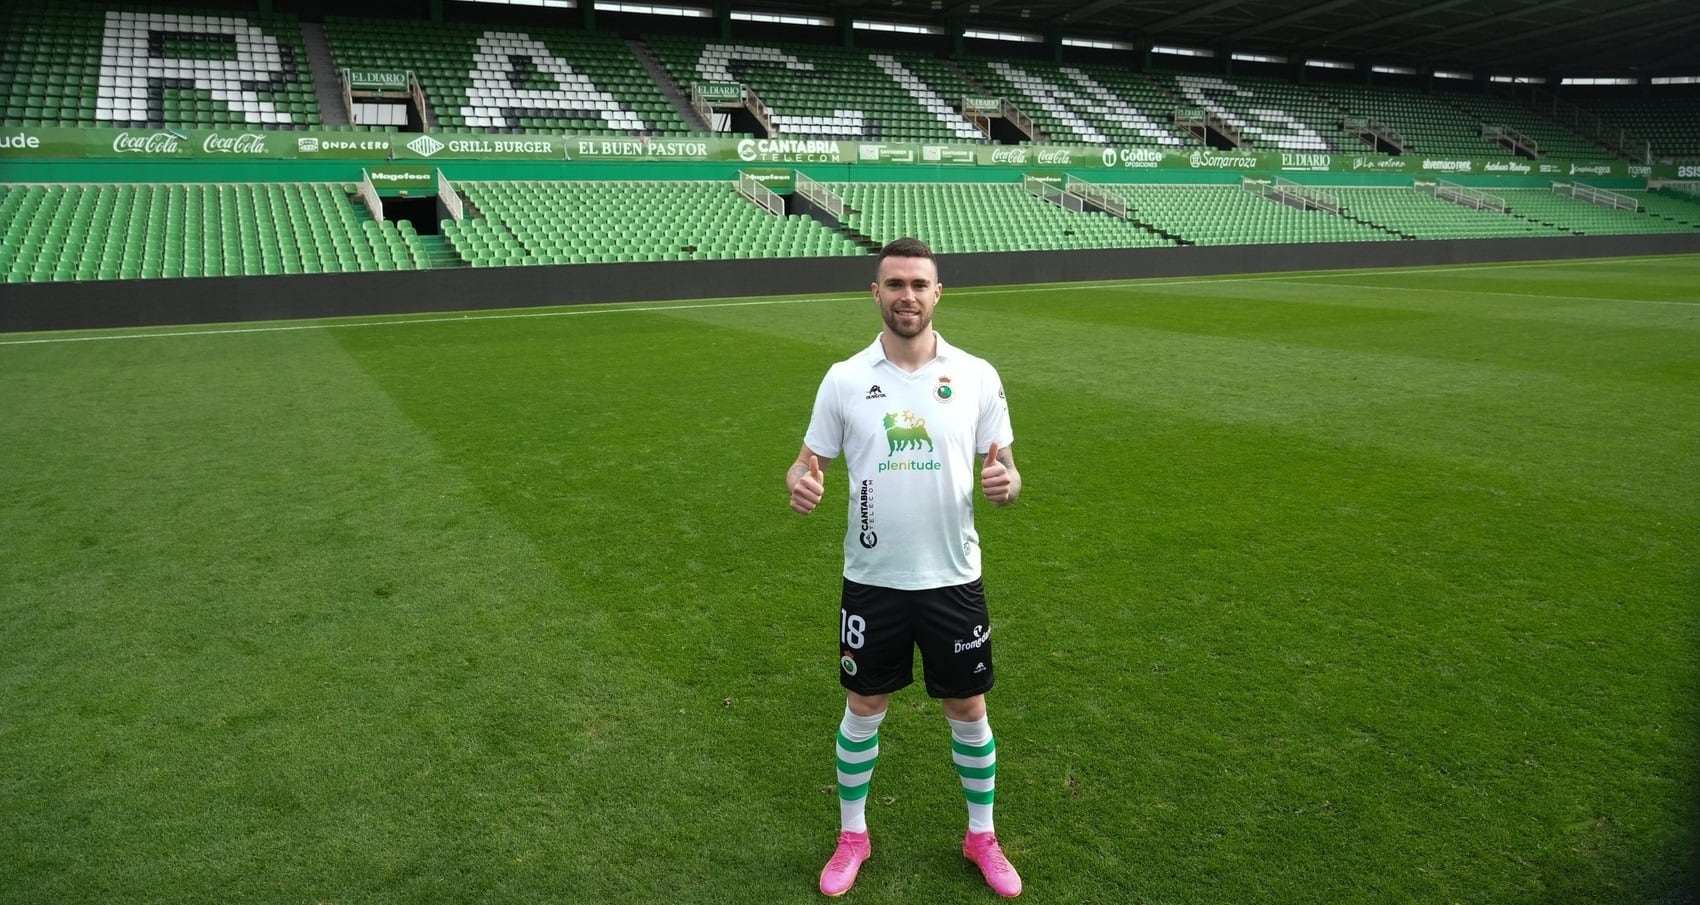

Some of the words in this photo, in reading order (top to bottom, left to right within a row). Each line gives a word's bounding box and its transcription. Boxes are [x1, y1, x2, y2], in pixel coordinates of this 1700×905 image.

[352, 72, 366, 81] EL
[367, 73, 405, 83] DIARIO
[710, 86, 739, 95] DIARIO
[113, 132, 179, 153] Coca-Cola
[203, 133, 267, 153] Coca-Cola
[322, 141, 356, 150] ONDA
[360, 141, 388, 150] CERO
[448, 141, 492, 152] GRILL
[494, 141, 552, 153] BURGER
[578, 141, 598, 155] EL
[602, 142, 643, 156] BUEN
[647, 142, 708, 156] PASTOR
[757, 140, 840, 153] CANTABRIA
[760, 153, 840, 162] TELECOM
[992, 148, 1028, 164] Coca-Cola
[1038, 149, 1072, 164] Coca-Cola
[1120, 149, 1162, 161] Códice
[1200, 151, 1257, 168] Somarroza
[1282, 153, 1297, 166] EL
[1296, 153, 1331, 167] DIARIO
[878, 460, 941, 472] plenitude
[860, 480, 869, 531] CANTABRIA
[838, 608, 866, 649] 18
